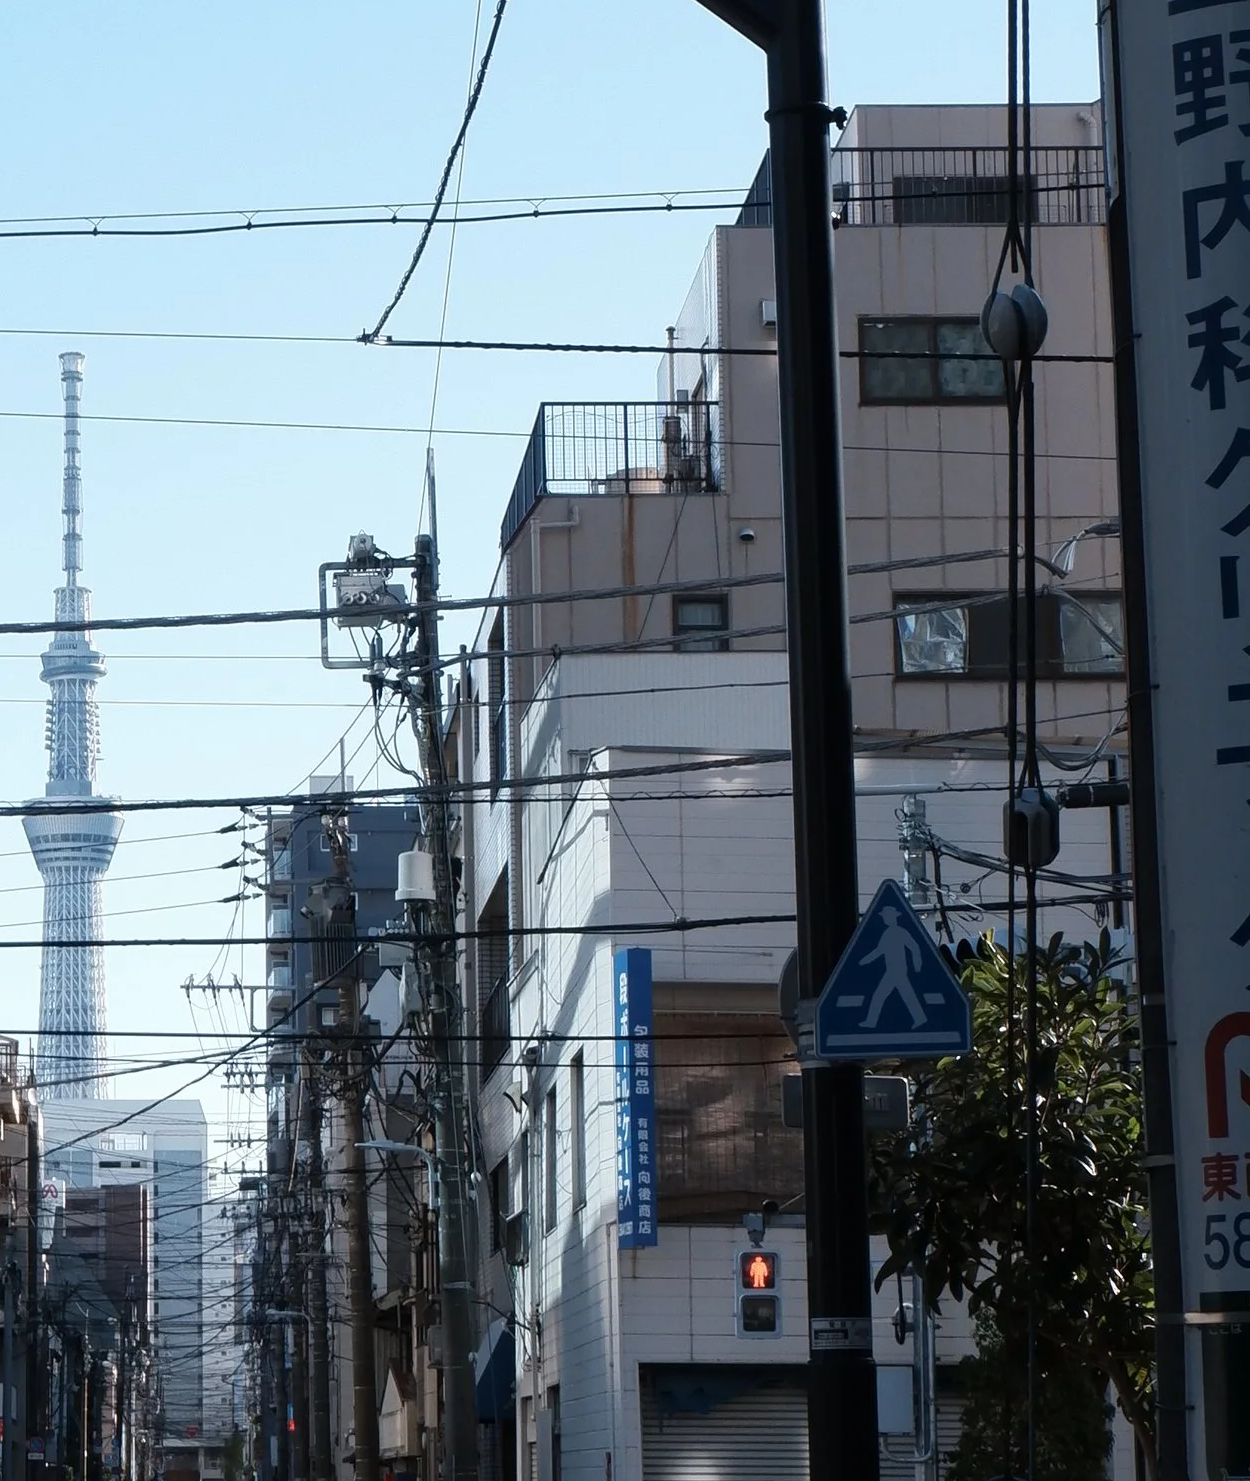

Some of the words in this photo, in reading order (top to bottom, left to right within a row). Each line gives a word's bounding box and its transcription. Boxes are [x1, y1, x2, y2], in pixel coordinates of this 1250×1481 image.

[634, 1024, 649, 1095] 包装用品
[637, 1118, 650, 1165] 有限会社
[637, 1170, 652, 1235] 向後商店
